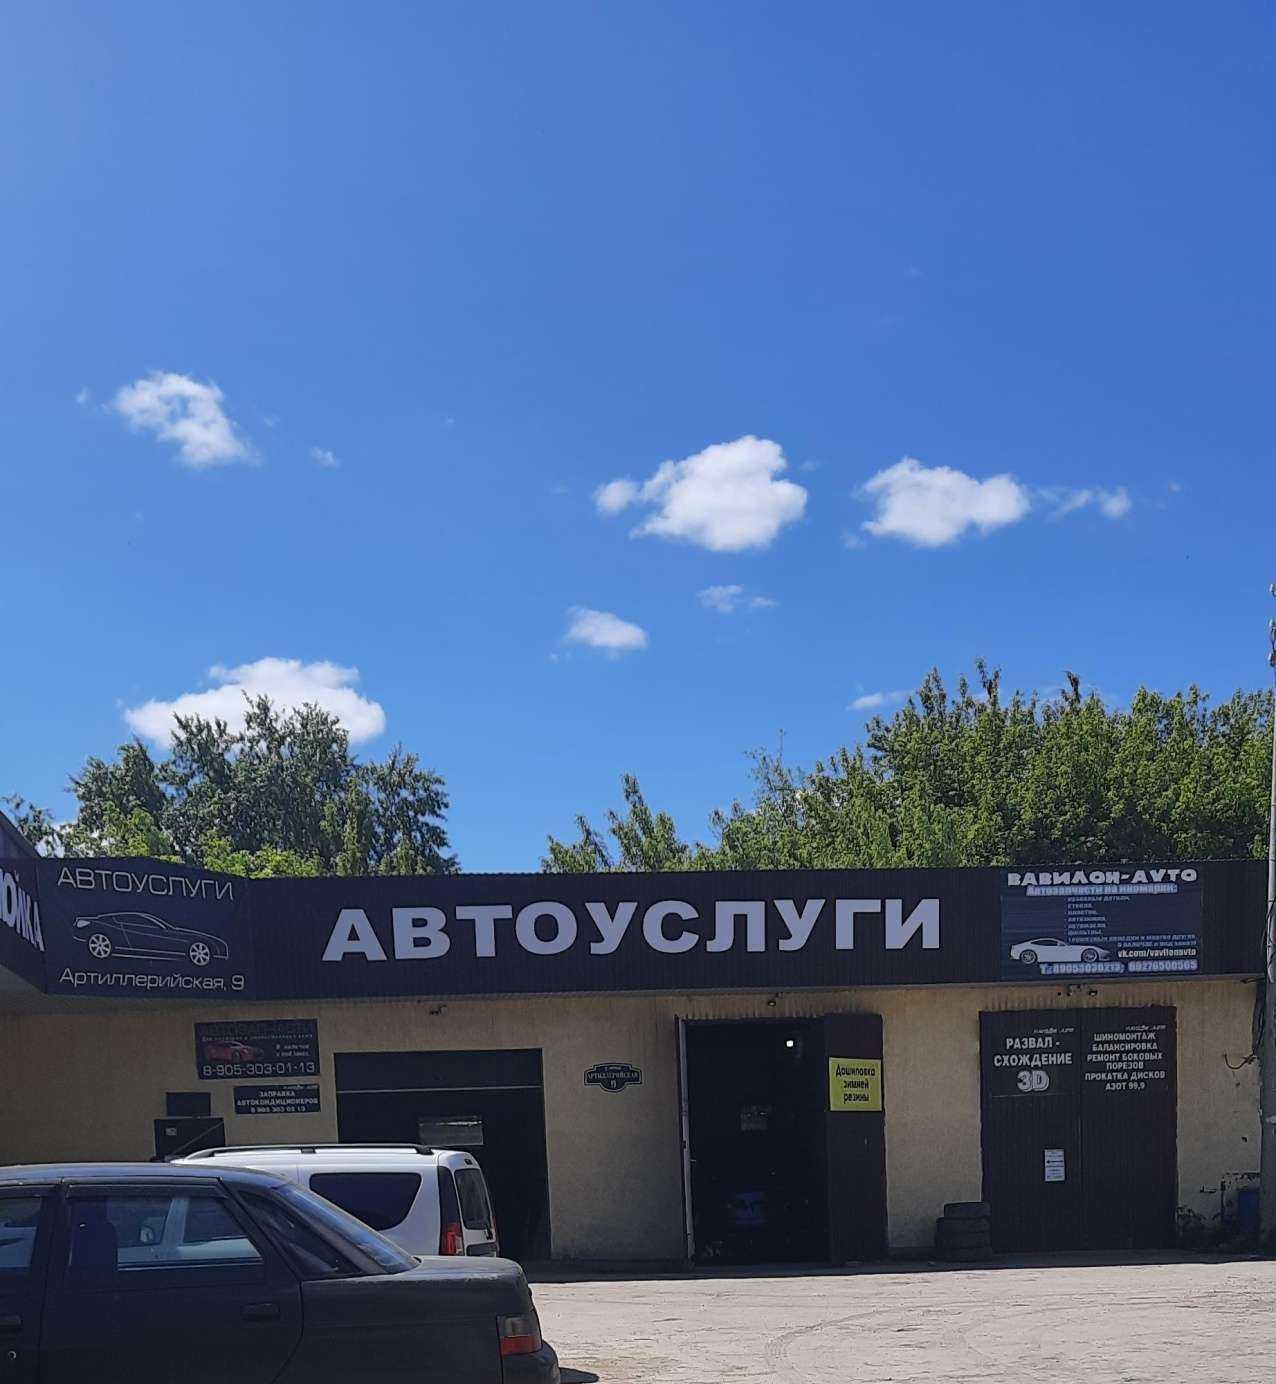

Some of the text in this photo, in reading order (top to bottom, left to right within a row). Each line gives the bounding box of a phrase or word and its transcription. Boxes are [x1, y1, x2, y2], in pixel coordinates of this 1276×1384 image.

[57, 867, 234, 900] АВТОУСЛУГИ
[0, 868, 45, 952] ОЙКА
[321, 898, 941, 962] АВТОУСЛУГИ
[59, 967, 245, 991] Артиллерийская, 9
[1006, 1036, 1053, 1050] РАЗВАЛ
[1093, 1032, 1156, 1042] ШИНОМОНТАЖ
[1092, 1042, 1158, 1052] БАЛАНСИРОВКА
[994, 1053, 1073, 1067] СХОЖДЕНИЕ
[1087, 1052, 1163, 1062] РЕМОНТ БОКОВЫХ
[202, 1062, 315, 1077] 8-905-303-01-13
[836, 1064, 876, 1077] Дошиповка
[1106, 1061, 1144, 1070] ПОРЕЗОВ
[1017, 1070, 1050, 1092] 3D
[1084, 1071, 1166, 1081] ПРОКАТКА ДИСКОВ
[843, 1079, 869, 1089] зимней
[1105, 1082, 1126, 1091] АЗОТ
